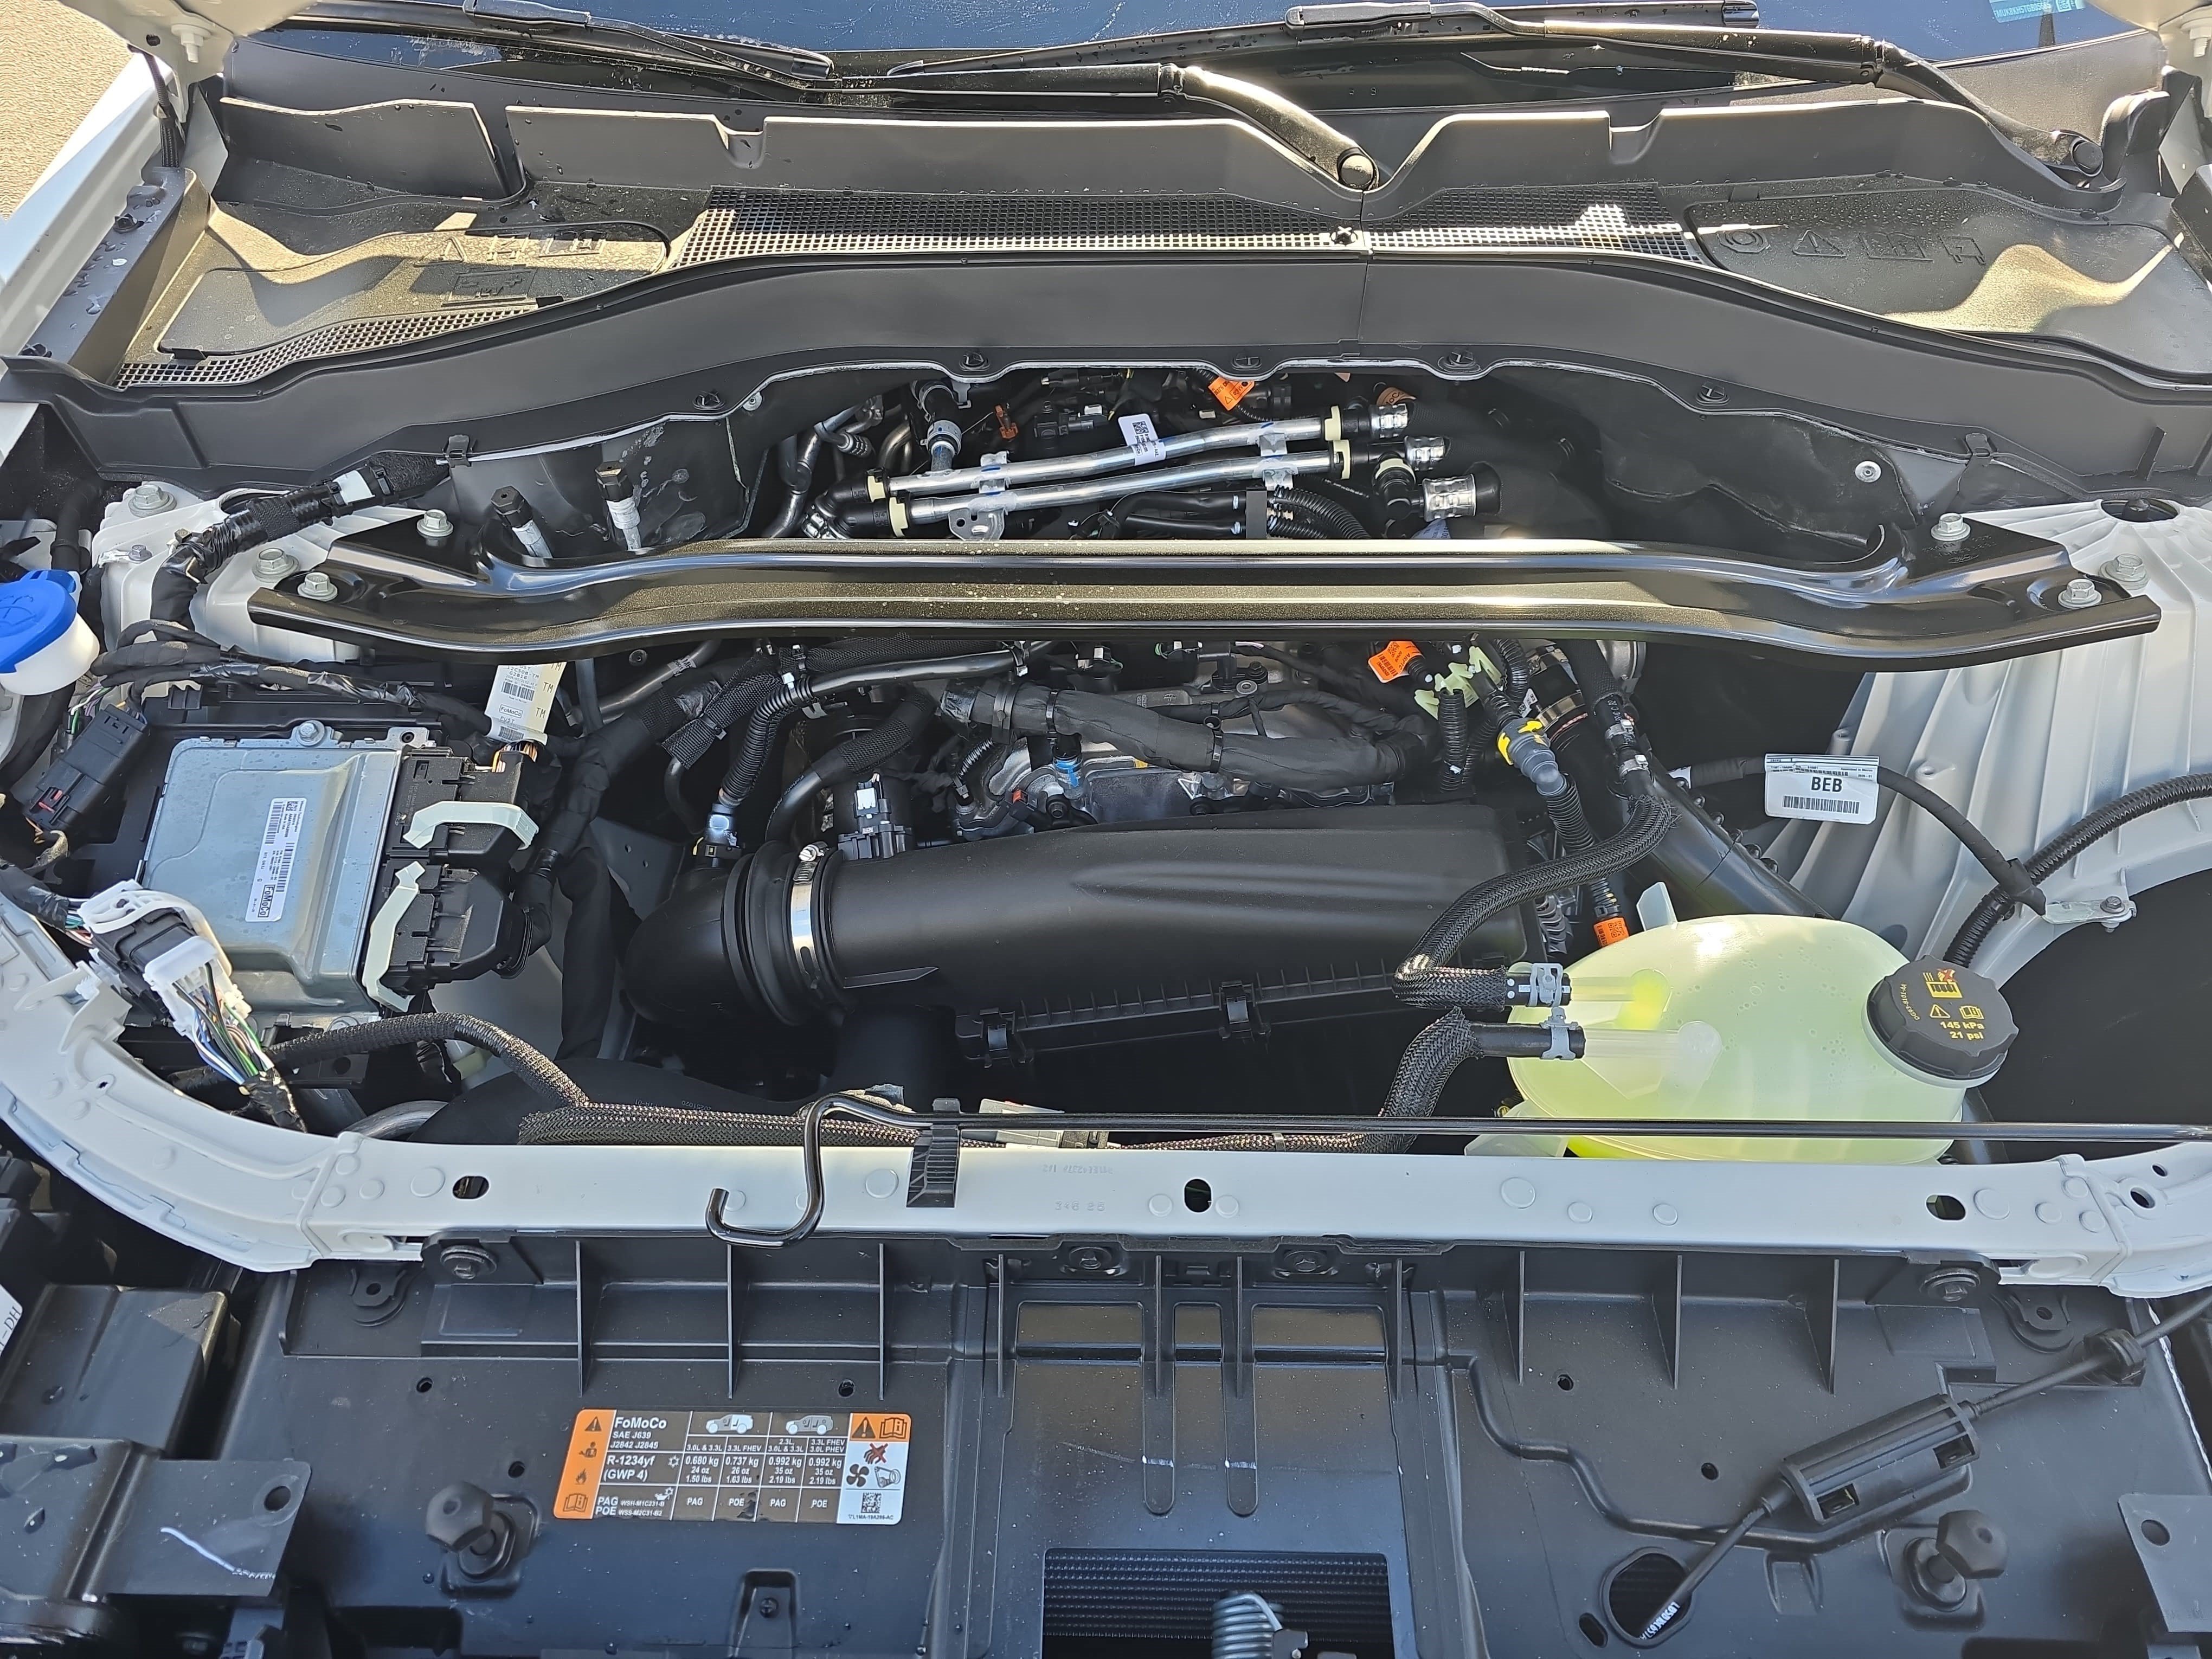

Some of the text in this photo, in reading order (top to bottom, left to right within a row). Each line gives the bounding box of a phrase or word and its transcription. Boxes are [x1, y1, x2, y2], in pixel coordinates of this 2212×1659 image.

[543, 681, 554, 693] TM
[500, 706, 521, 716] FoMoCo
[536, 707, 546, 718] TM
[1811, 776, 1843, 793] BEB
[260, 886, 274, 916] FoMoCo
[1966, 1032, 1984, 1040] psi
[614, 1417, 667, 1429] FoMoCo
[607, 1455, 655, 1468] R-1234yf
[686, 1456, 719, 1467] 0.680 kg
[725, 1456, 759, 1468] 0.737 kg
[769, 1456, 802, 1468] 0.992 kg
[809, 1457, 842, 1469] 0.992 kg
[603, 1469, 648, 1482] (GWP 4)
[775, 1467, 783, 1475] 35
[686, 1475, 700, 1483] 1.50
[726, 1475, 752, 1483] 1.63 lbs
[769, 1476, 784, 1484] 2.19
[597, 1496, 619, 1506] PAG
[687, 1497, 703, 1506] PAG
[729, 1497, 745, 1506] POE
[770, 1499, 786, 1507] PAG
[812, 1499, 828, 1508] POE
[595, 1506, 617, 1515] POE
